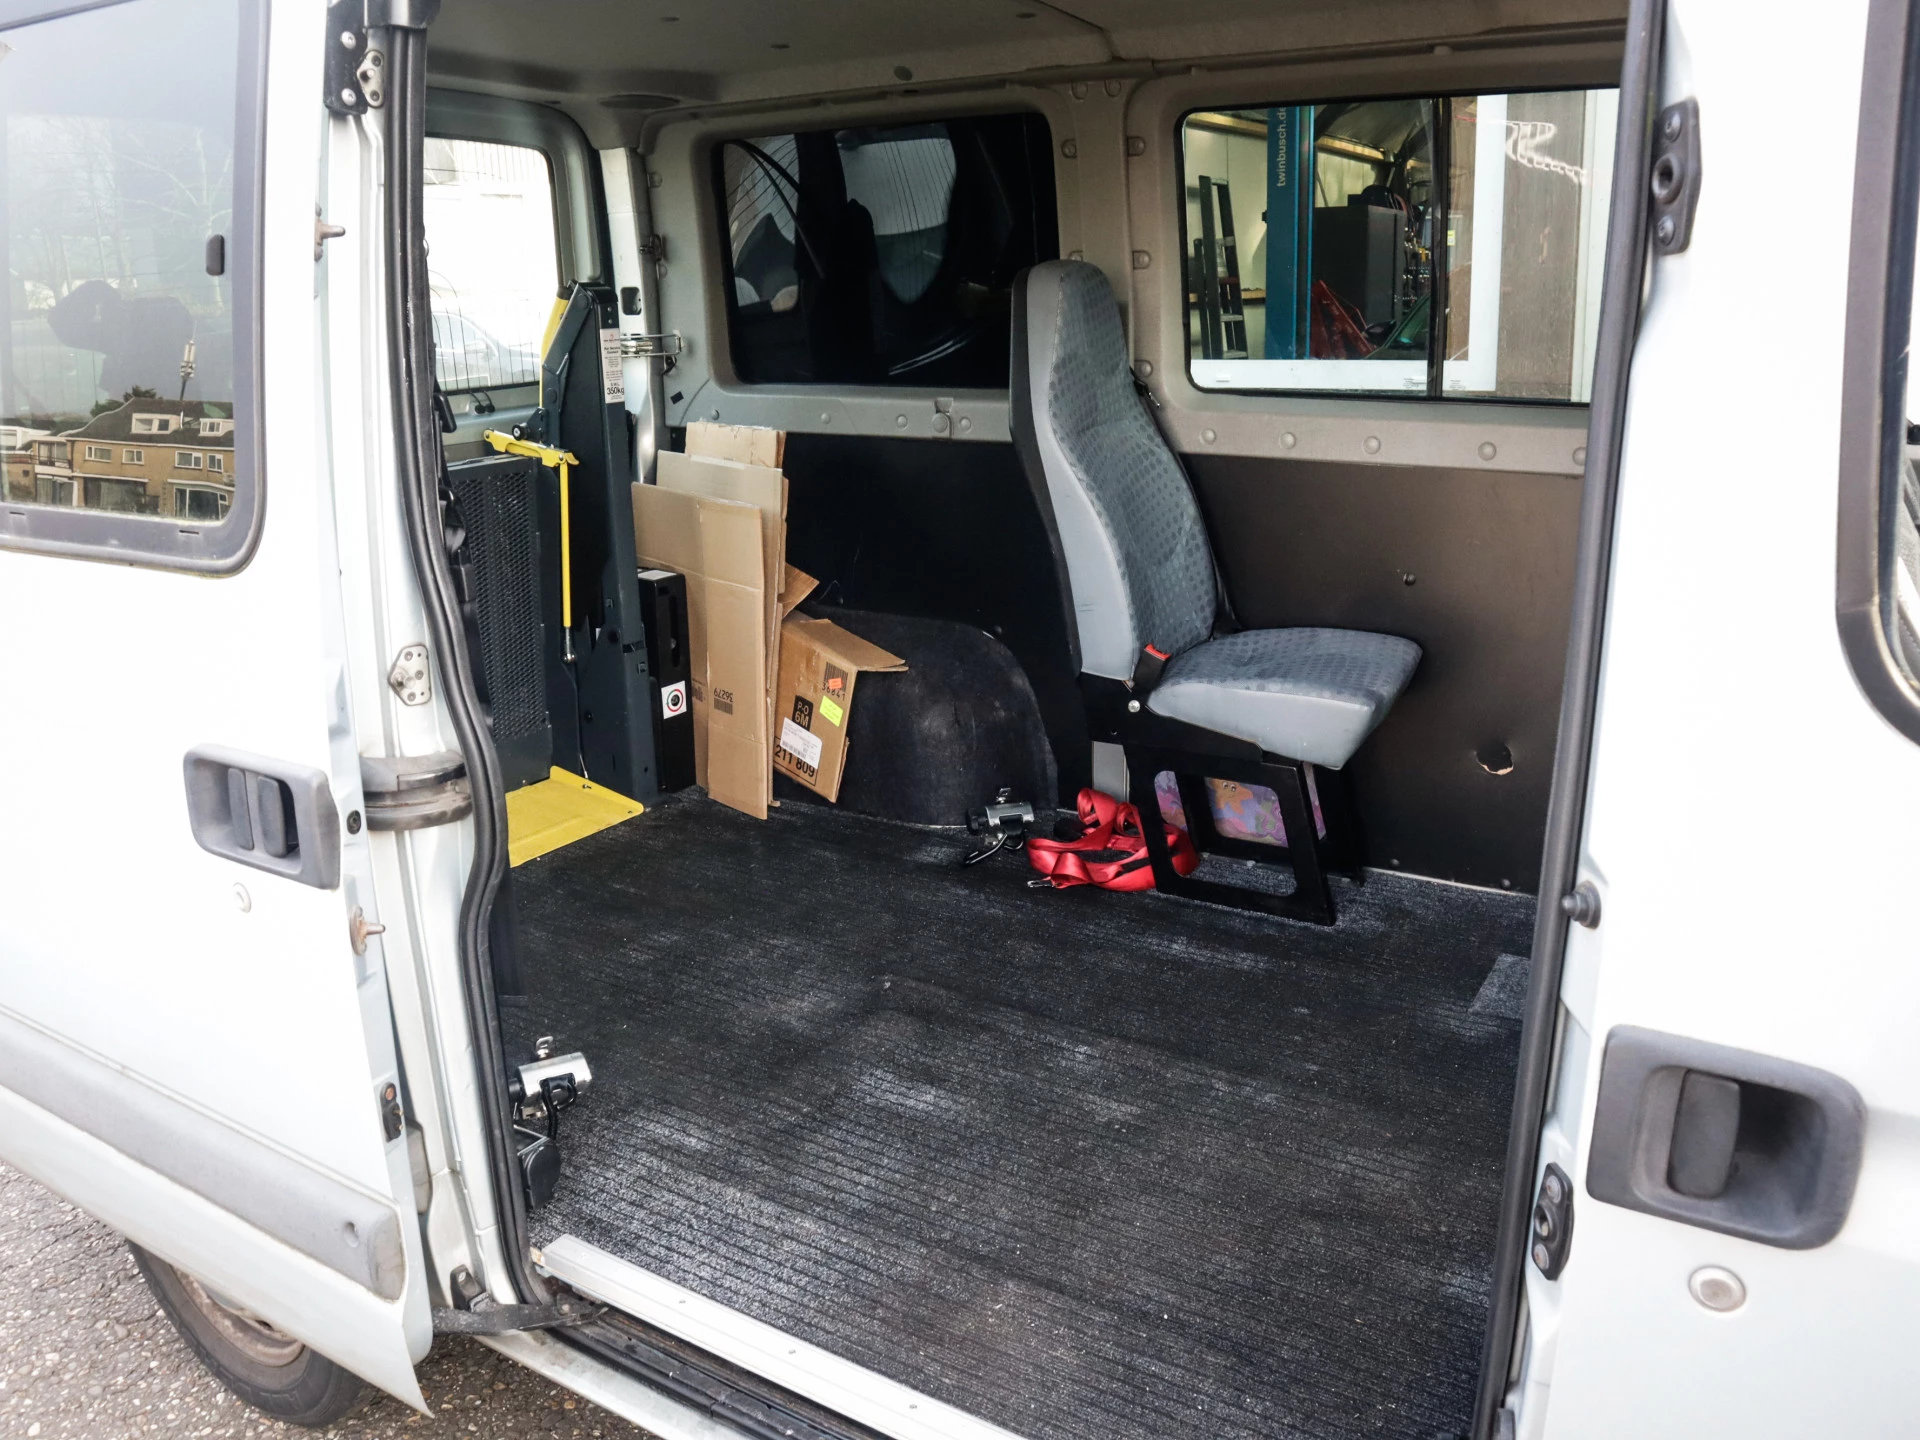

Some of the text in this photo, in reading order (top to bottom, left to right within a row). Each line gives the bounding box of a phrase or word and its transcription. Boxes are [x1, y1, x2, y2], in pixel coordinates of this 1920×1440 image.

[1276, 107, 1287, 187] twinbusch.de
[606, 387, 625, 396] 350kg
[713, 687, 734, 702] 36279
[795, 711, 809, 728] 6M
[774, 744, 816, 778] 211 809
